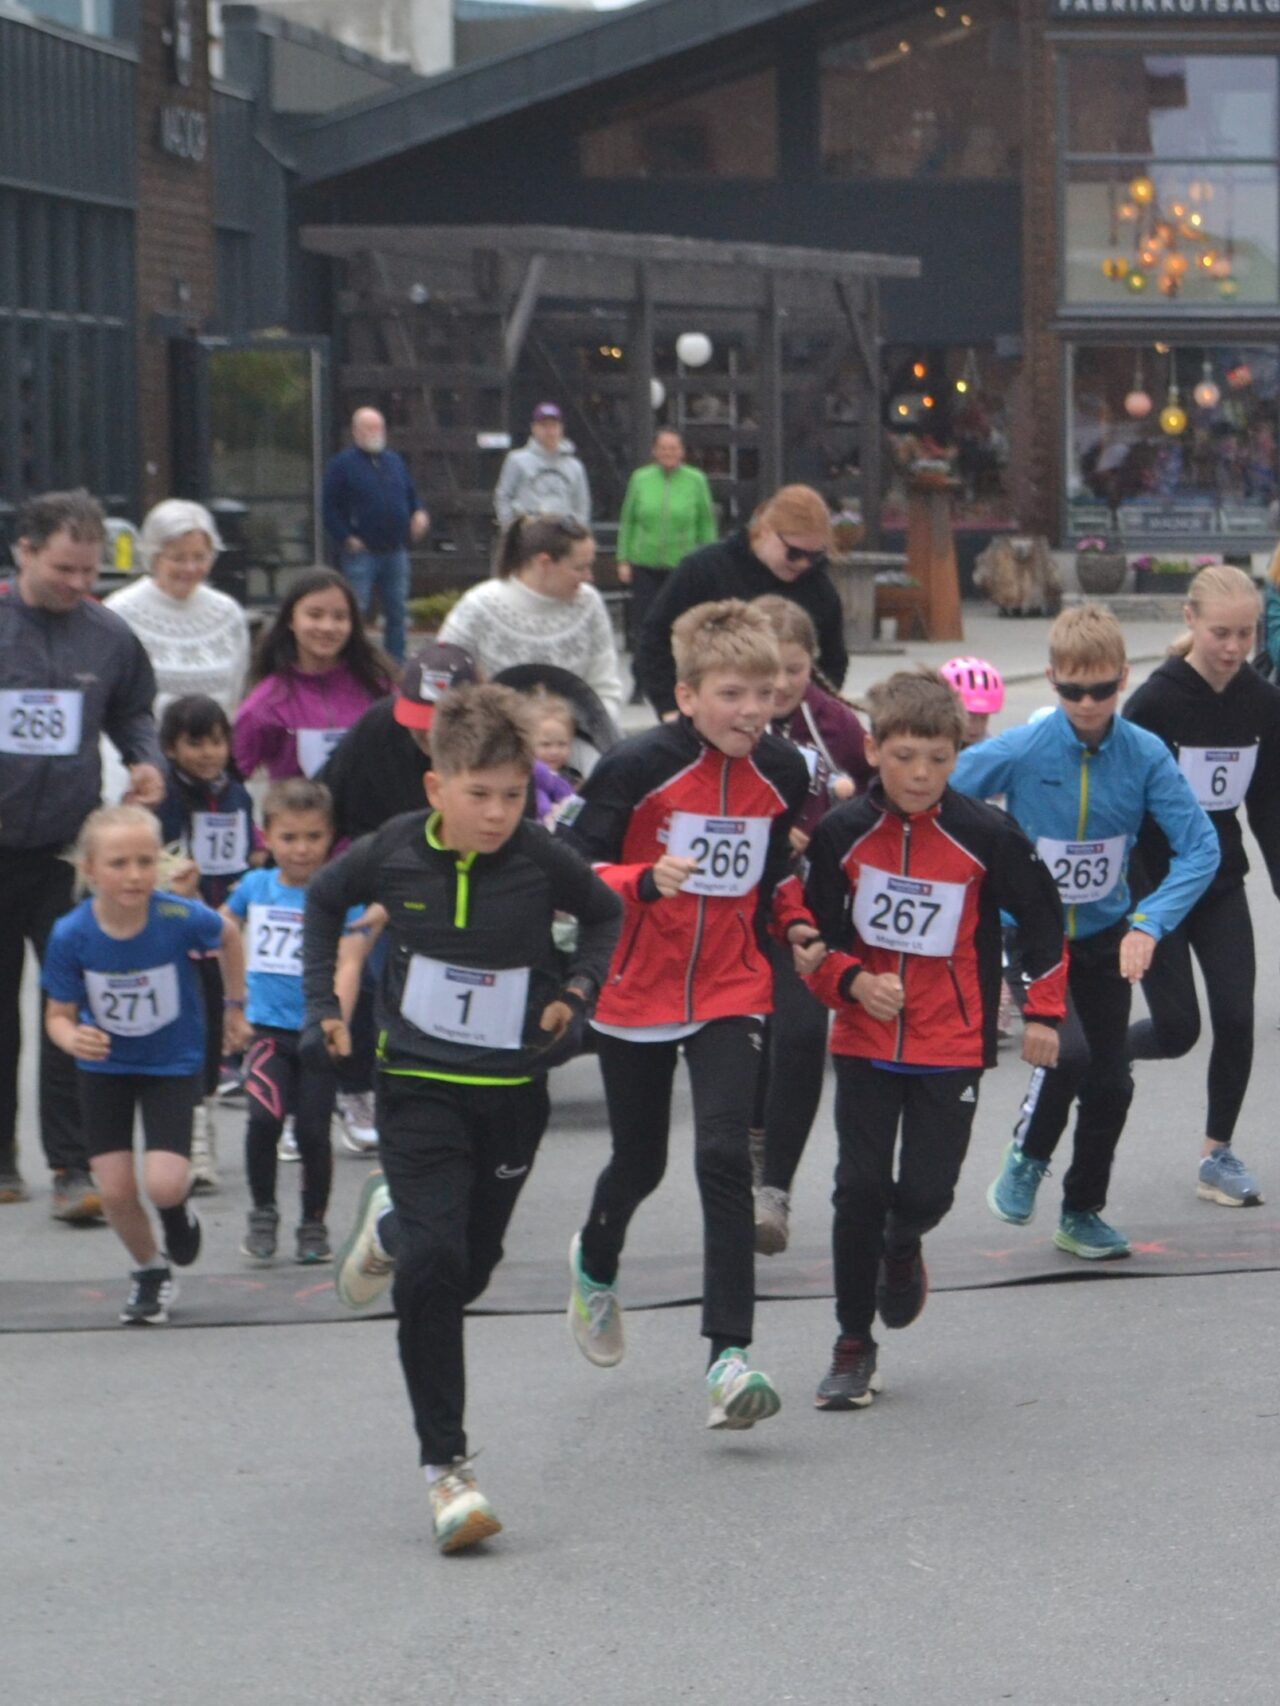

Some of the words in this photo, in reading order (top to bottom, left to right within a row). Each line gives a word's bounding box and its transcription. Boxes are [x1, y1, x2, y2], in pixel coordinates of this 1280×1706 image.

[10, 707, 65, 740] 268
[1211, 766, 1228, 797] 6
[207, 832, 236, 860] 18
[689, 837, 751, 878] 266
[1054, 857, 1109, 889] 263
[869, 893, 942, 937] 267
[258, 925, 304, 959] 272
[101, 988, 160, 1021] 271
[456, 990, 473, 1025] 1
